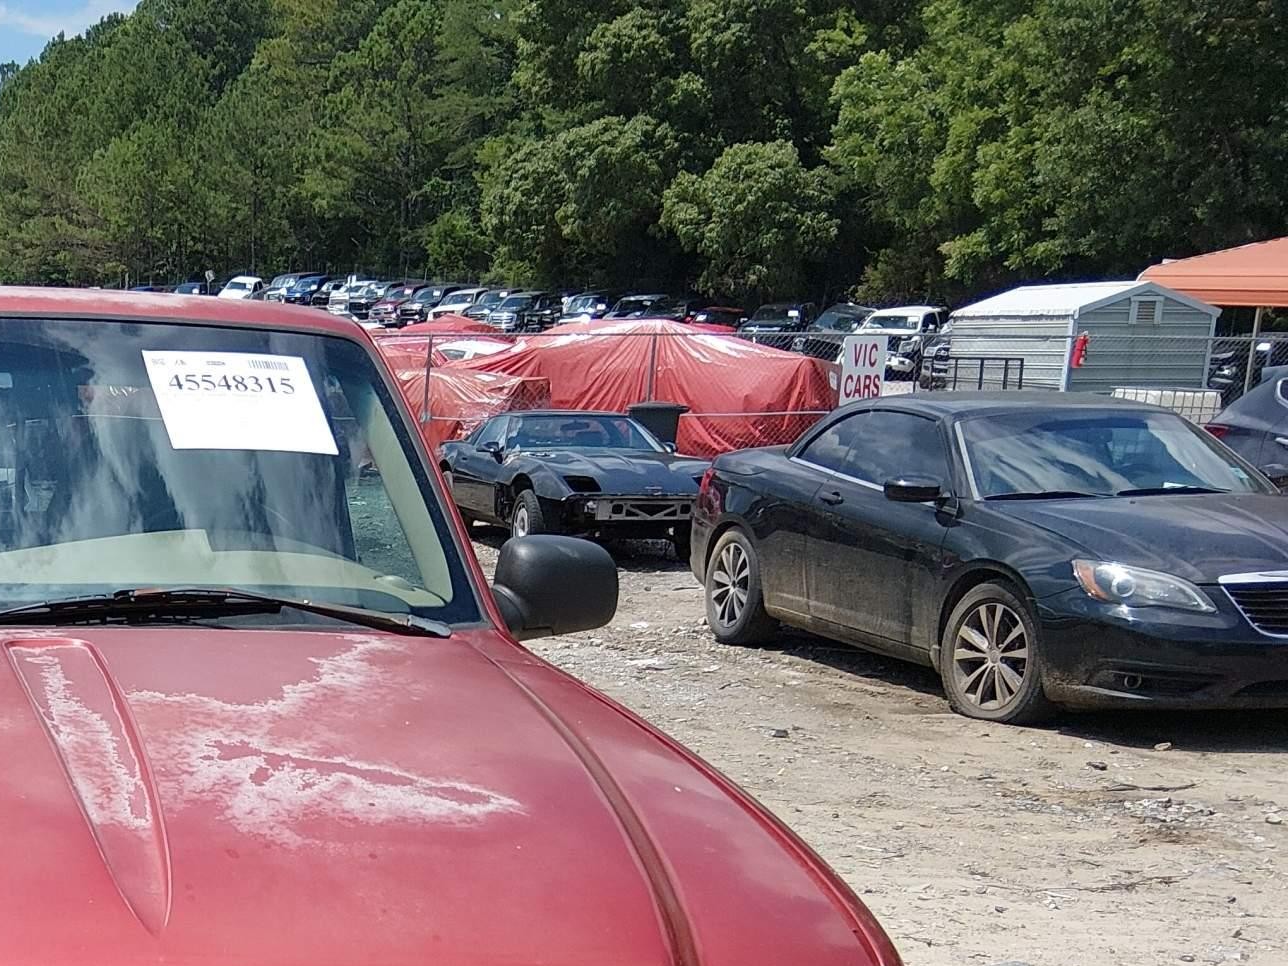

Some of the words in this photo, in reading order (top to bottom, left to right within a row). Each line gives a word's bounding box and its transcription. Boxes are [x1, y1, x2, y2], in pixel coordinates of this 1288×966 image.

[854, 343, 879, 367] VIC
[168, 374, 295, 394] 45548315
[844, 374, 881, 398] CARS
